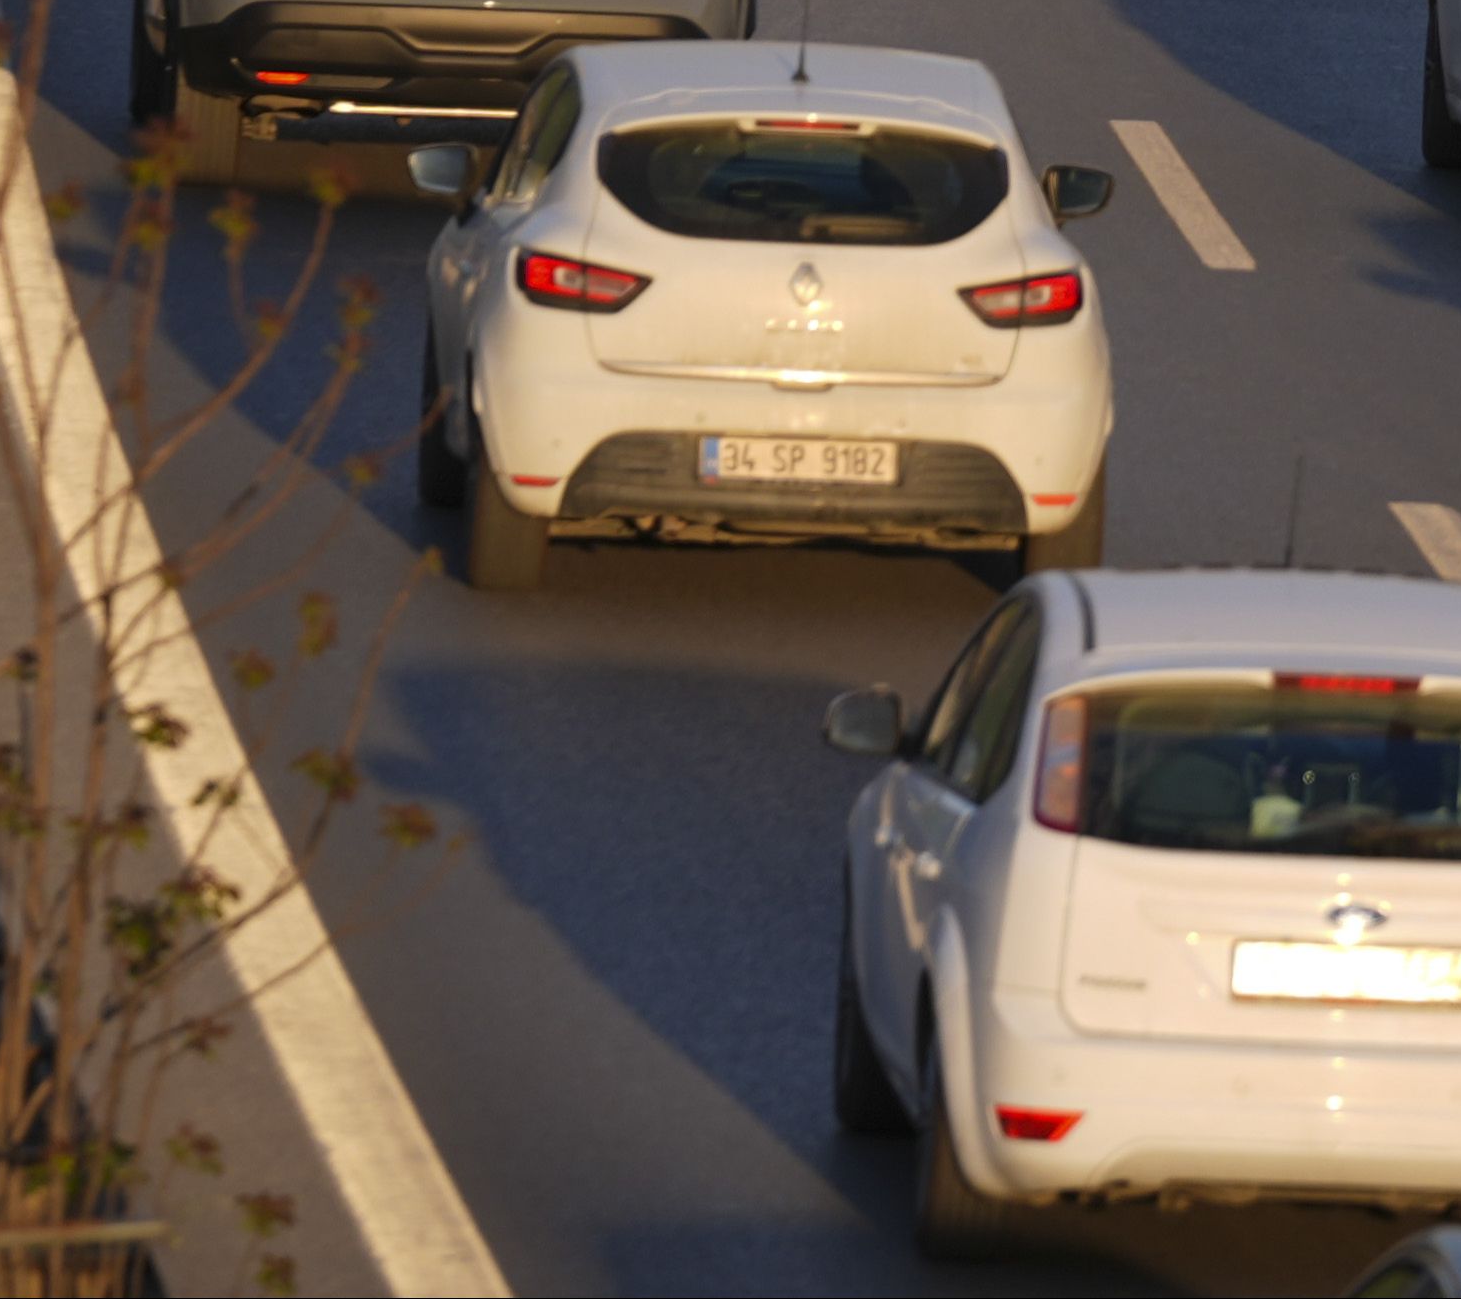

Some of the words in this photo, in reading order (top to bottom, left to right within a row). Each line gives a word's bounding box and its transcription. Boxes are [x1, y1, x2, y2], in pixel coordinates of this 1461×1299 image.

[720, 443, 757, 471] 34
[771, 445, 806, 474] SP
[822, 447, 887, 476] 9182
